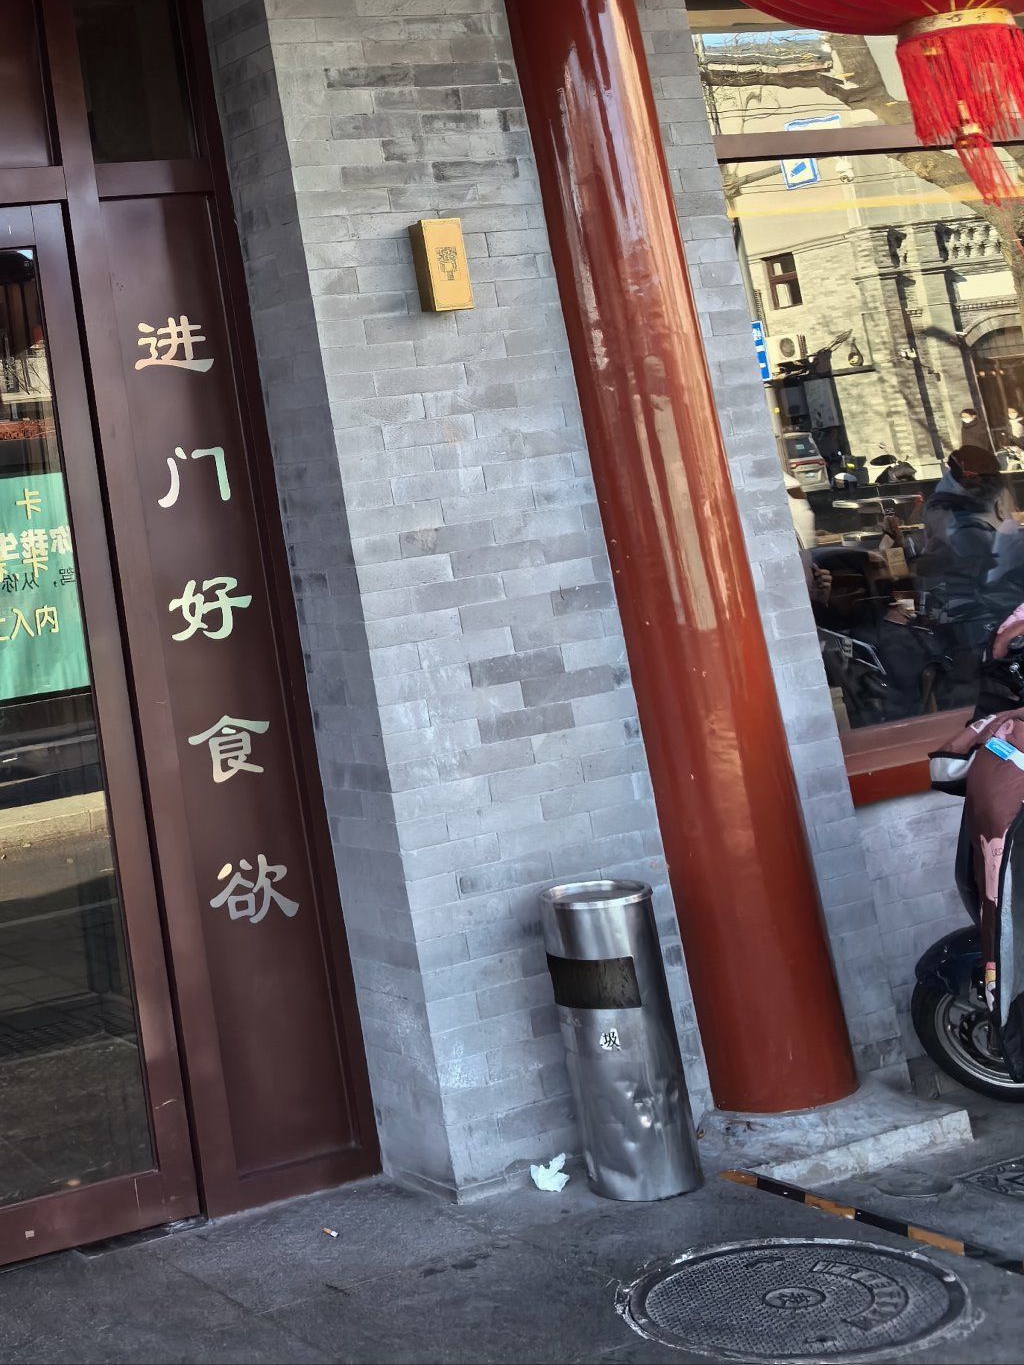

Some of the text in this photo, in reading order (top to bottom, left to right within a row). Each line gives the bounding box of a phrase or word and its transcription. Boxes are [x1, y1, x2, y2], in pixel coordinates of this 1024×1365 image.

[16, 488, 42, 521] 卡
[135, 315, 300, 924] 进门好食欲
